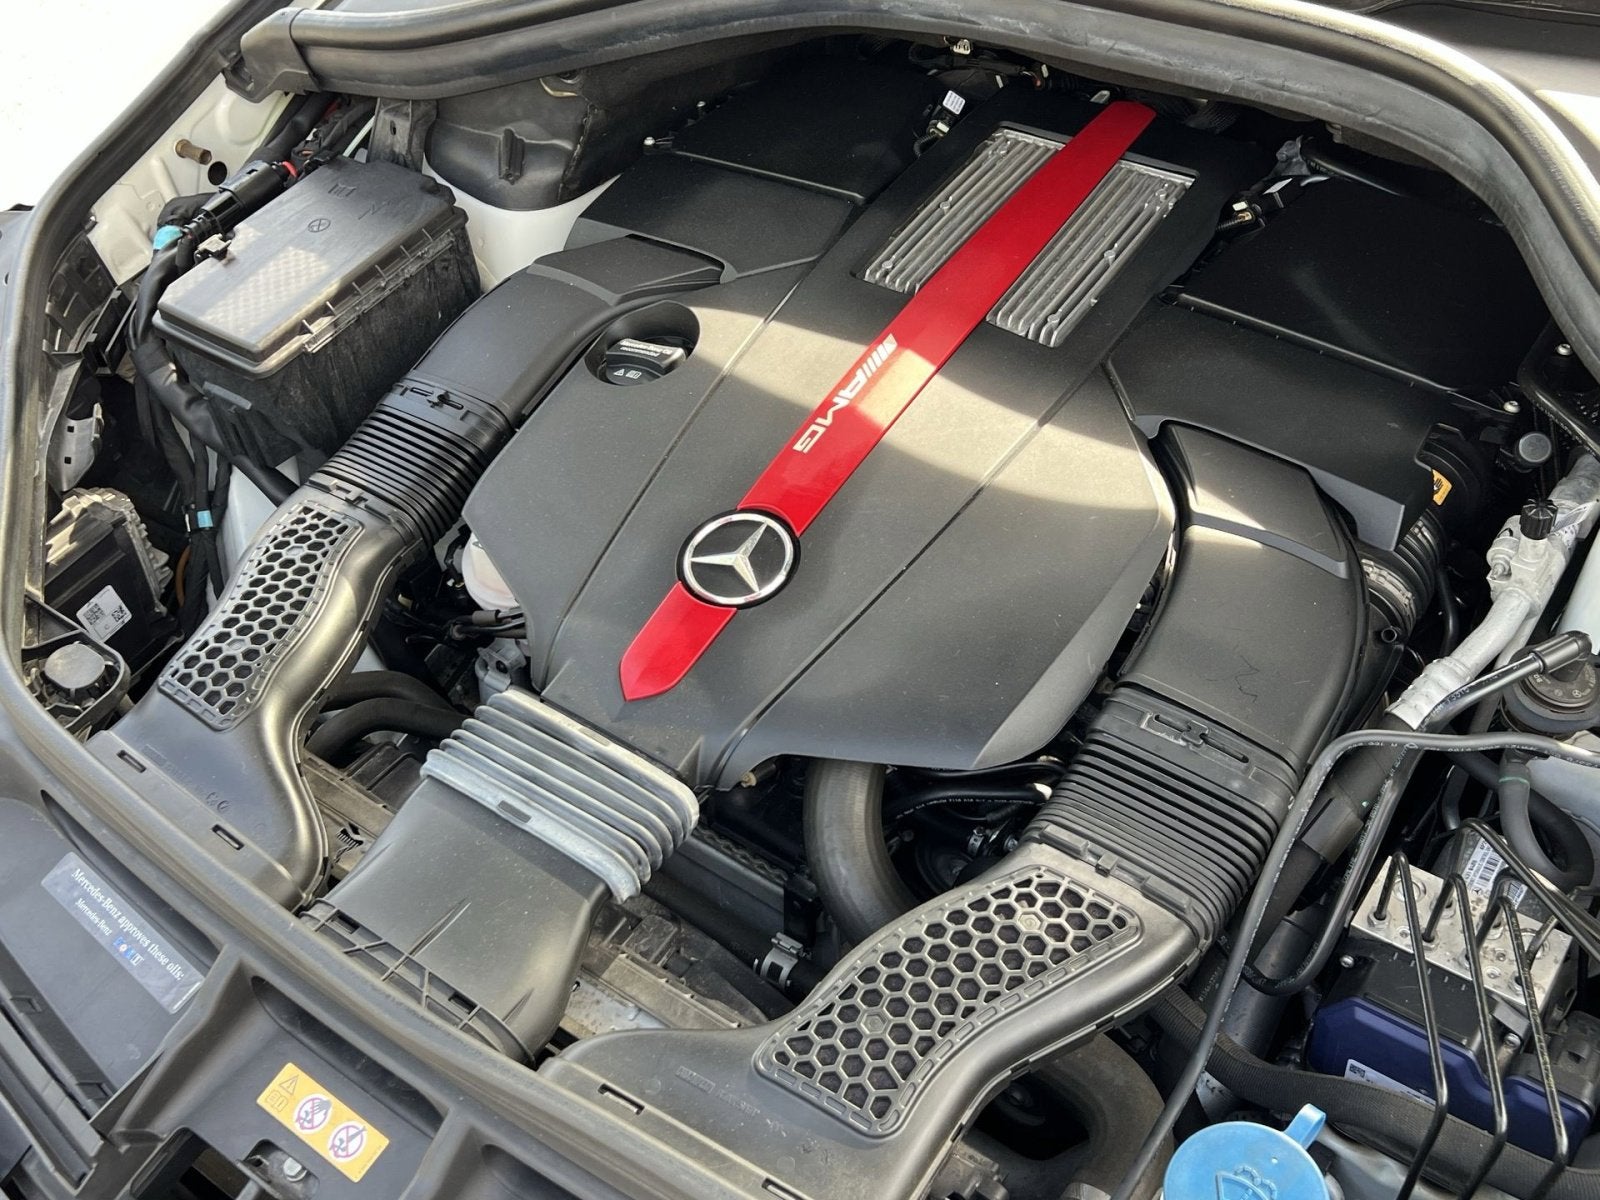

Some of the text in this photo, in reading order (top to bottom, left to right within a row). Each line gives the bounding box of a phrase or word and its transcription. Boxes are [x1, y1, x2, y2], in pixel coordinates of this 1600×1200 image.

[792, 367, 868, 454] AMG
[71, 868, 122, 919] Mercedes-Benz
[118, 914, 151, 948] approves
[147, 943, 169, 966] these
[75, 898, 113, 937] Mercedes-Benz
